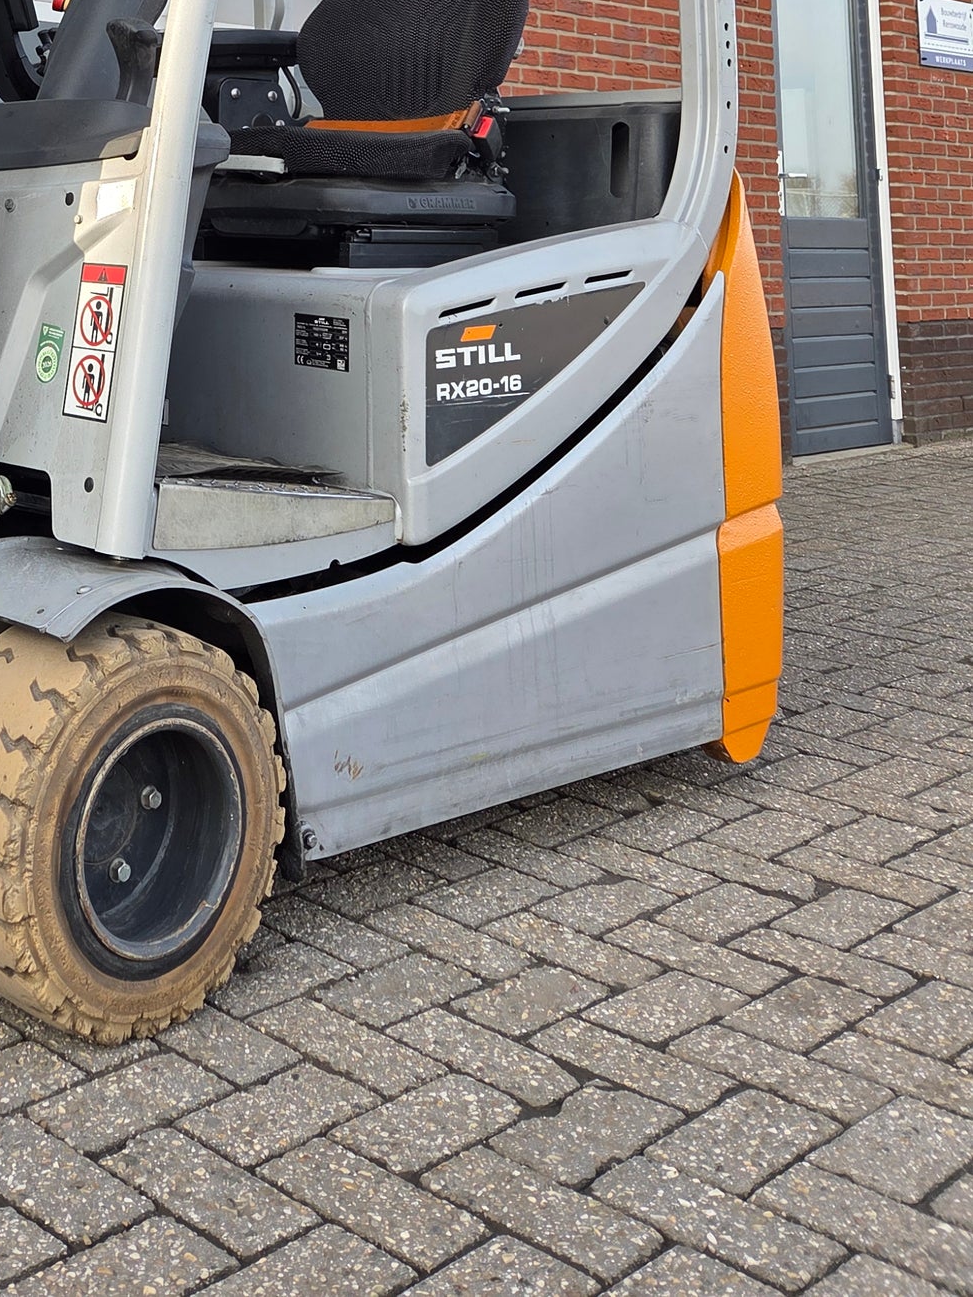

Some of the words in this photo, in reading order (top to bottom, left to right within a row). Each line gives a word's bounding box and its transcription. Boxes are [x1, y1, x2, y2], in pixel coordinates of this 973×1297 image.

[419, 197, 476, 209] GRAMMER
[435, 342, 521, 369] STILL
[436, 374, 522, 401] RX20-16
